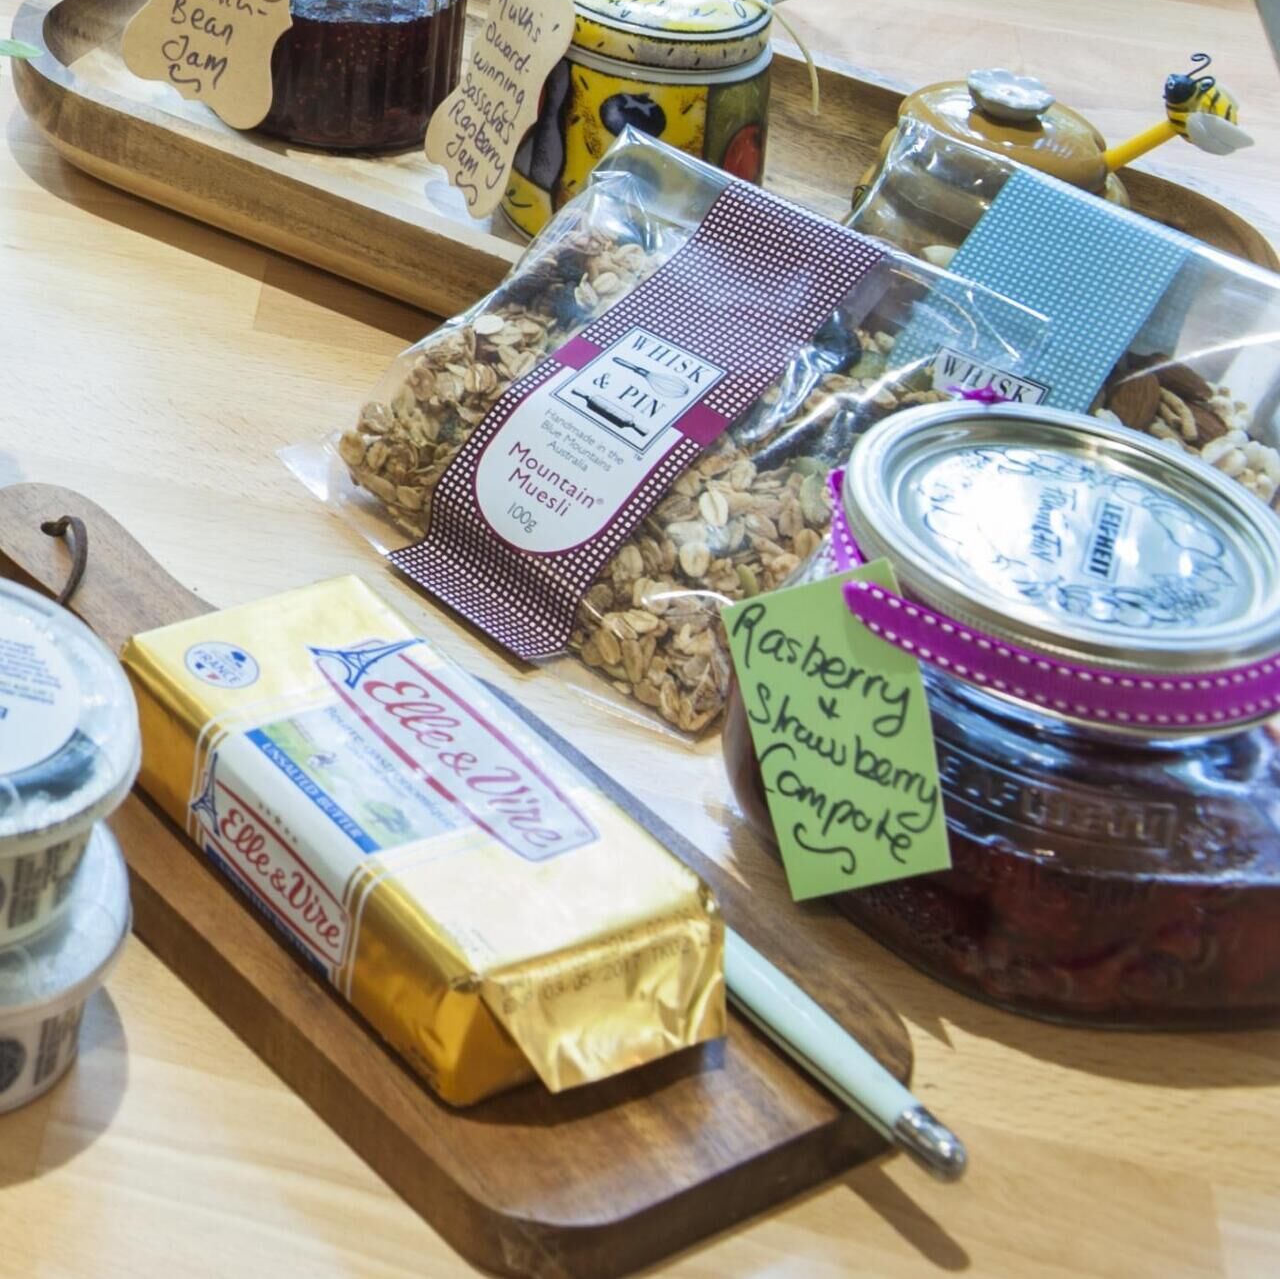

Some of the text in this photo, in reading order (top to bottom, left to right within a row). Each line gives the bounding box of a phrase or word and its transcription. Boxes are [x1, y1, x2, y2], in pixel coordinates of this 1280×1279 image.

[161, 35, 228, 90] Jam
[446, 133, 480, 177] Jam
[631, 334, 712, 384] WHISK
[942, 354, 1032, 404] WHISK
[592, 372, 666, 418] & PIN
[540, 420, 613, 473] Blue Mountains
[544, 408, 625, 466] Handmade in the
[546, 440, 589, 473] Australia
[506, 501, 538, 534] 100g
[508, 467, 570, 518] Muesli
[194, 649, 241, 685] FRANCE
[732, 603, 910, 738] Rasberry
[362, 680, 462, 750] Elle
[437, 751, 479, 777] &
[465, 765, 563, 849] Vire
[748, 682, 939, 834] Strawberry
[262, 742, 320, 797] UNSALTED
[315, 796, 364, 838] BUTTER
[220, 808, 271, 877] Elle
[289, 871, 341, 948] Vire
